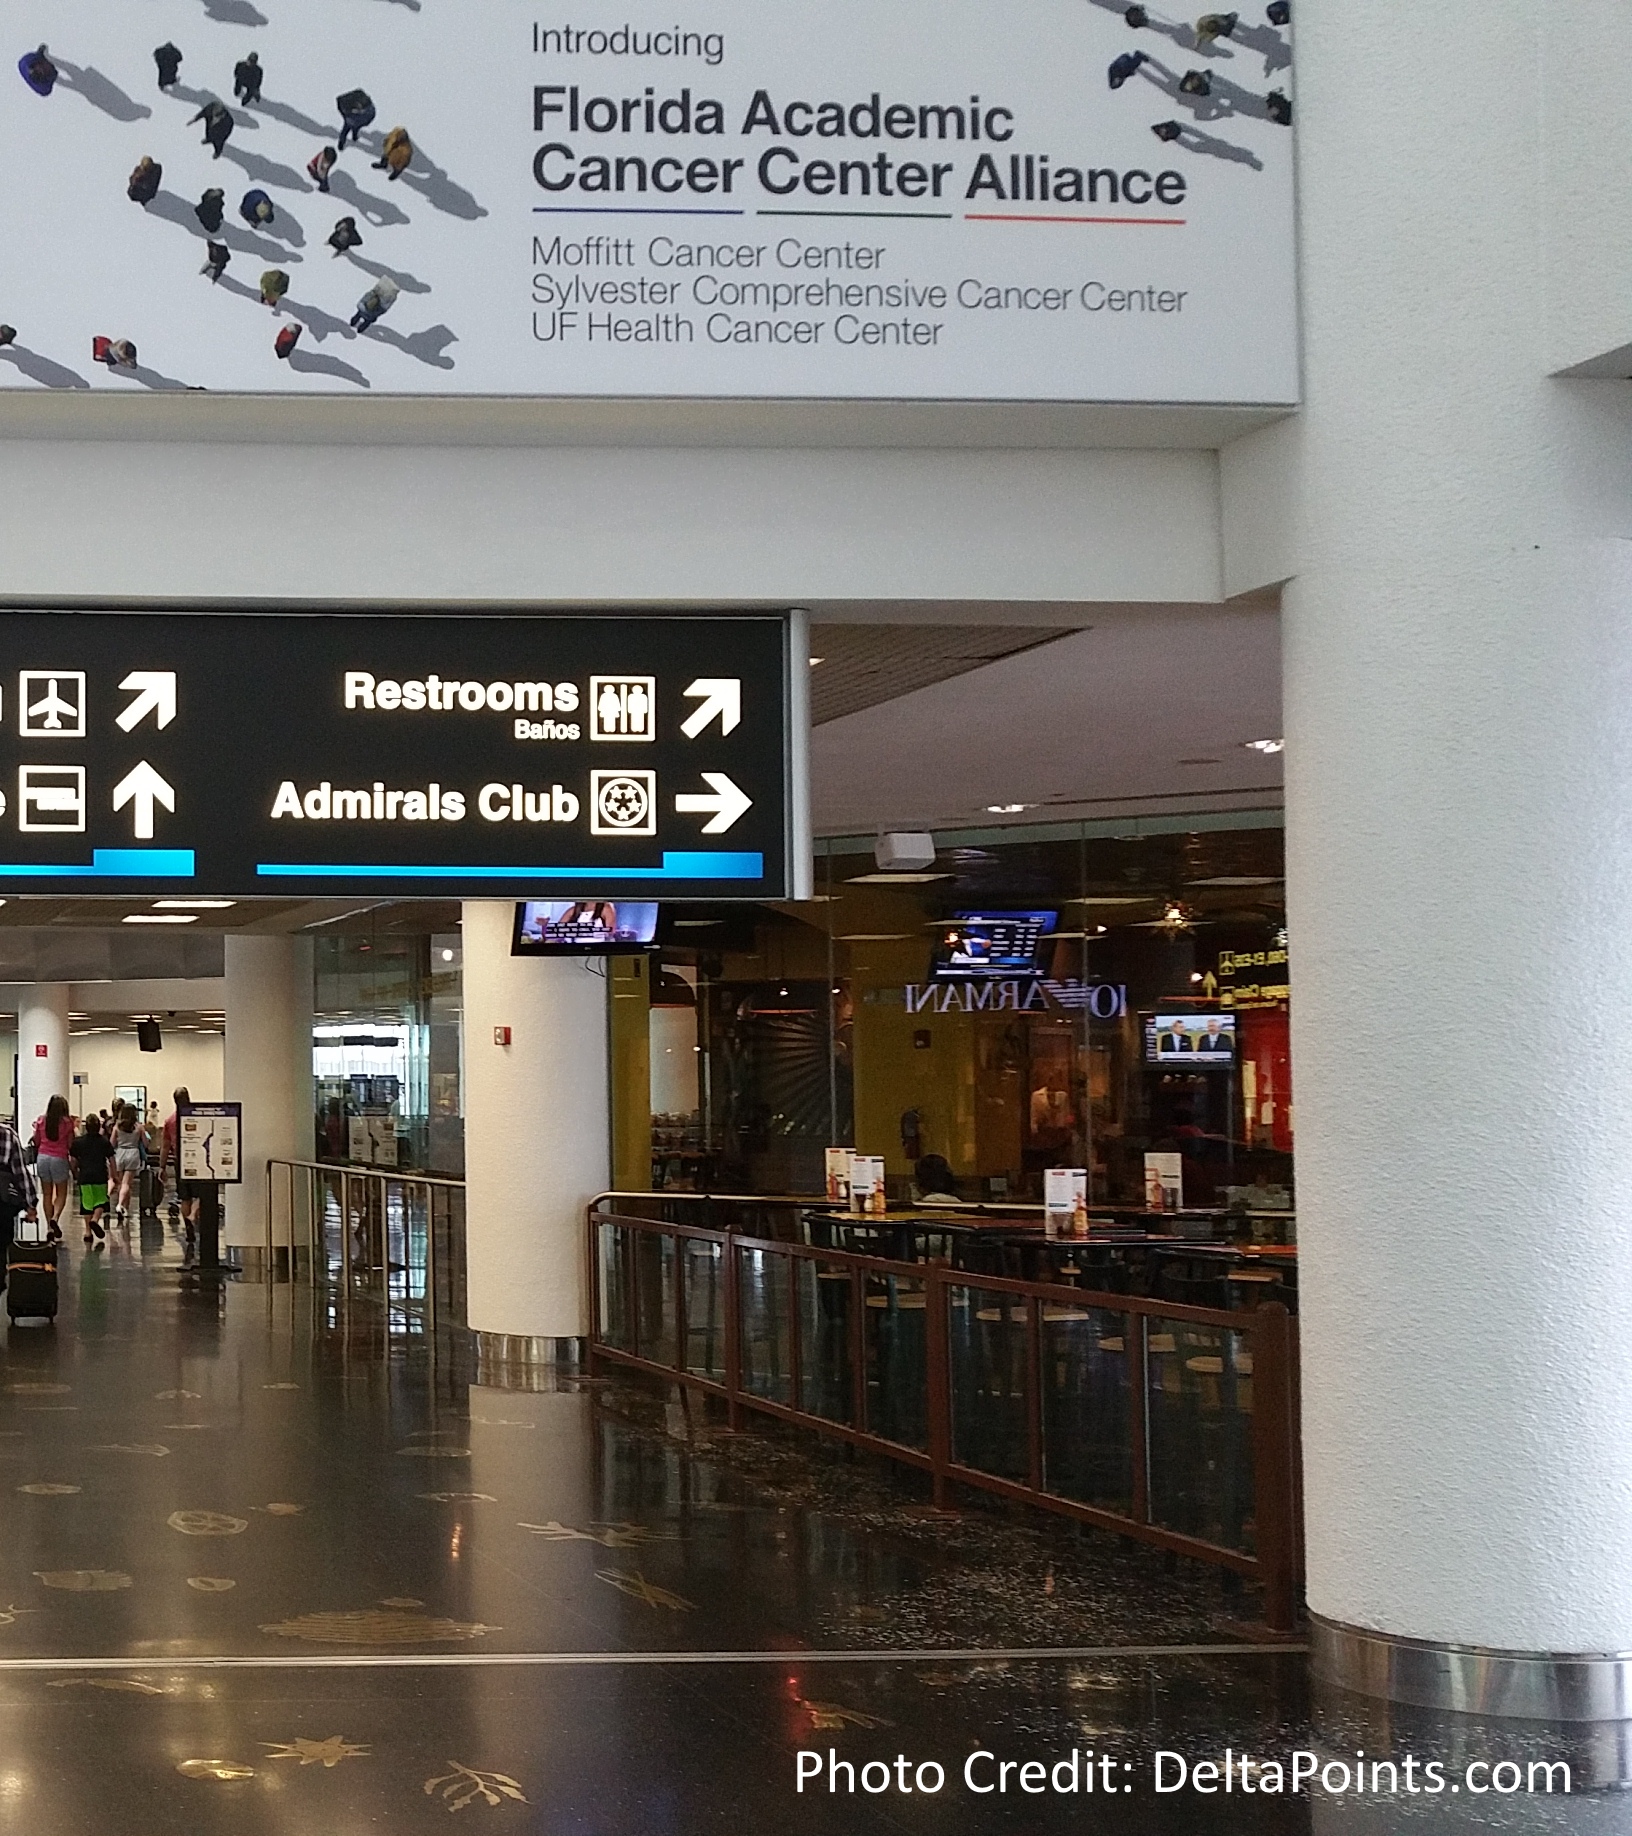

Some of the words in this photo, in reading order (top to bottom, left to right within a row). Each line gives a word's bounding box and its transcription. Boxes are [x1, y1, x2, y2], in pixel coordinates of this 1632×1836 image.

[533, 22, 725, 65] Introducing
[533, 85, 725, 135] Florida
[740, 89, 1014, 143] Academic
[532, 142, 744, 194] Cancer
[757, 146, 954, 198] Center
[964, 153, 1187, 206] Alliance
[532, 235, 635, 267] Moffitt
[648, 236, 767, 268] Cancer
[776, 238, 886, 270] Center
[531, 273, 682, 311] Sylvester
[692, 274, 947, 313] Comprehensive
[957, 278, 1073, 311] Cancer
[1080, 281, 1188, 313] Center
[532, 311, 578, 342] UF
[588, 311, 694, 342] Health
[706, 312, 825, 344] Cancer
[834, 314, 944, 346] Center
[344, 671, 580, 712] Restrooms
[514, 718, 581, 740] Baños
[270, 781, 466, 821] Admirals
[478, 782, 580, 822] Club
